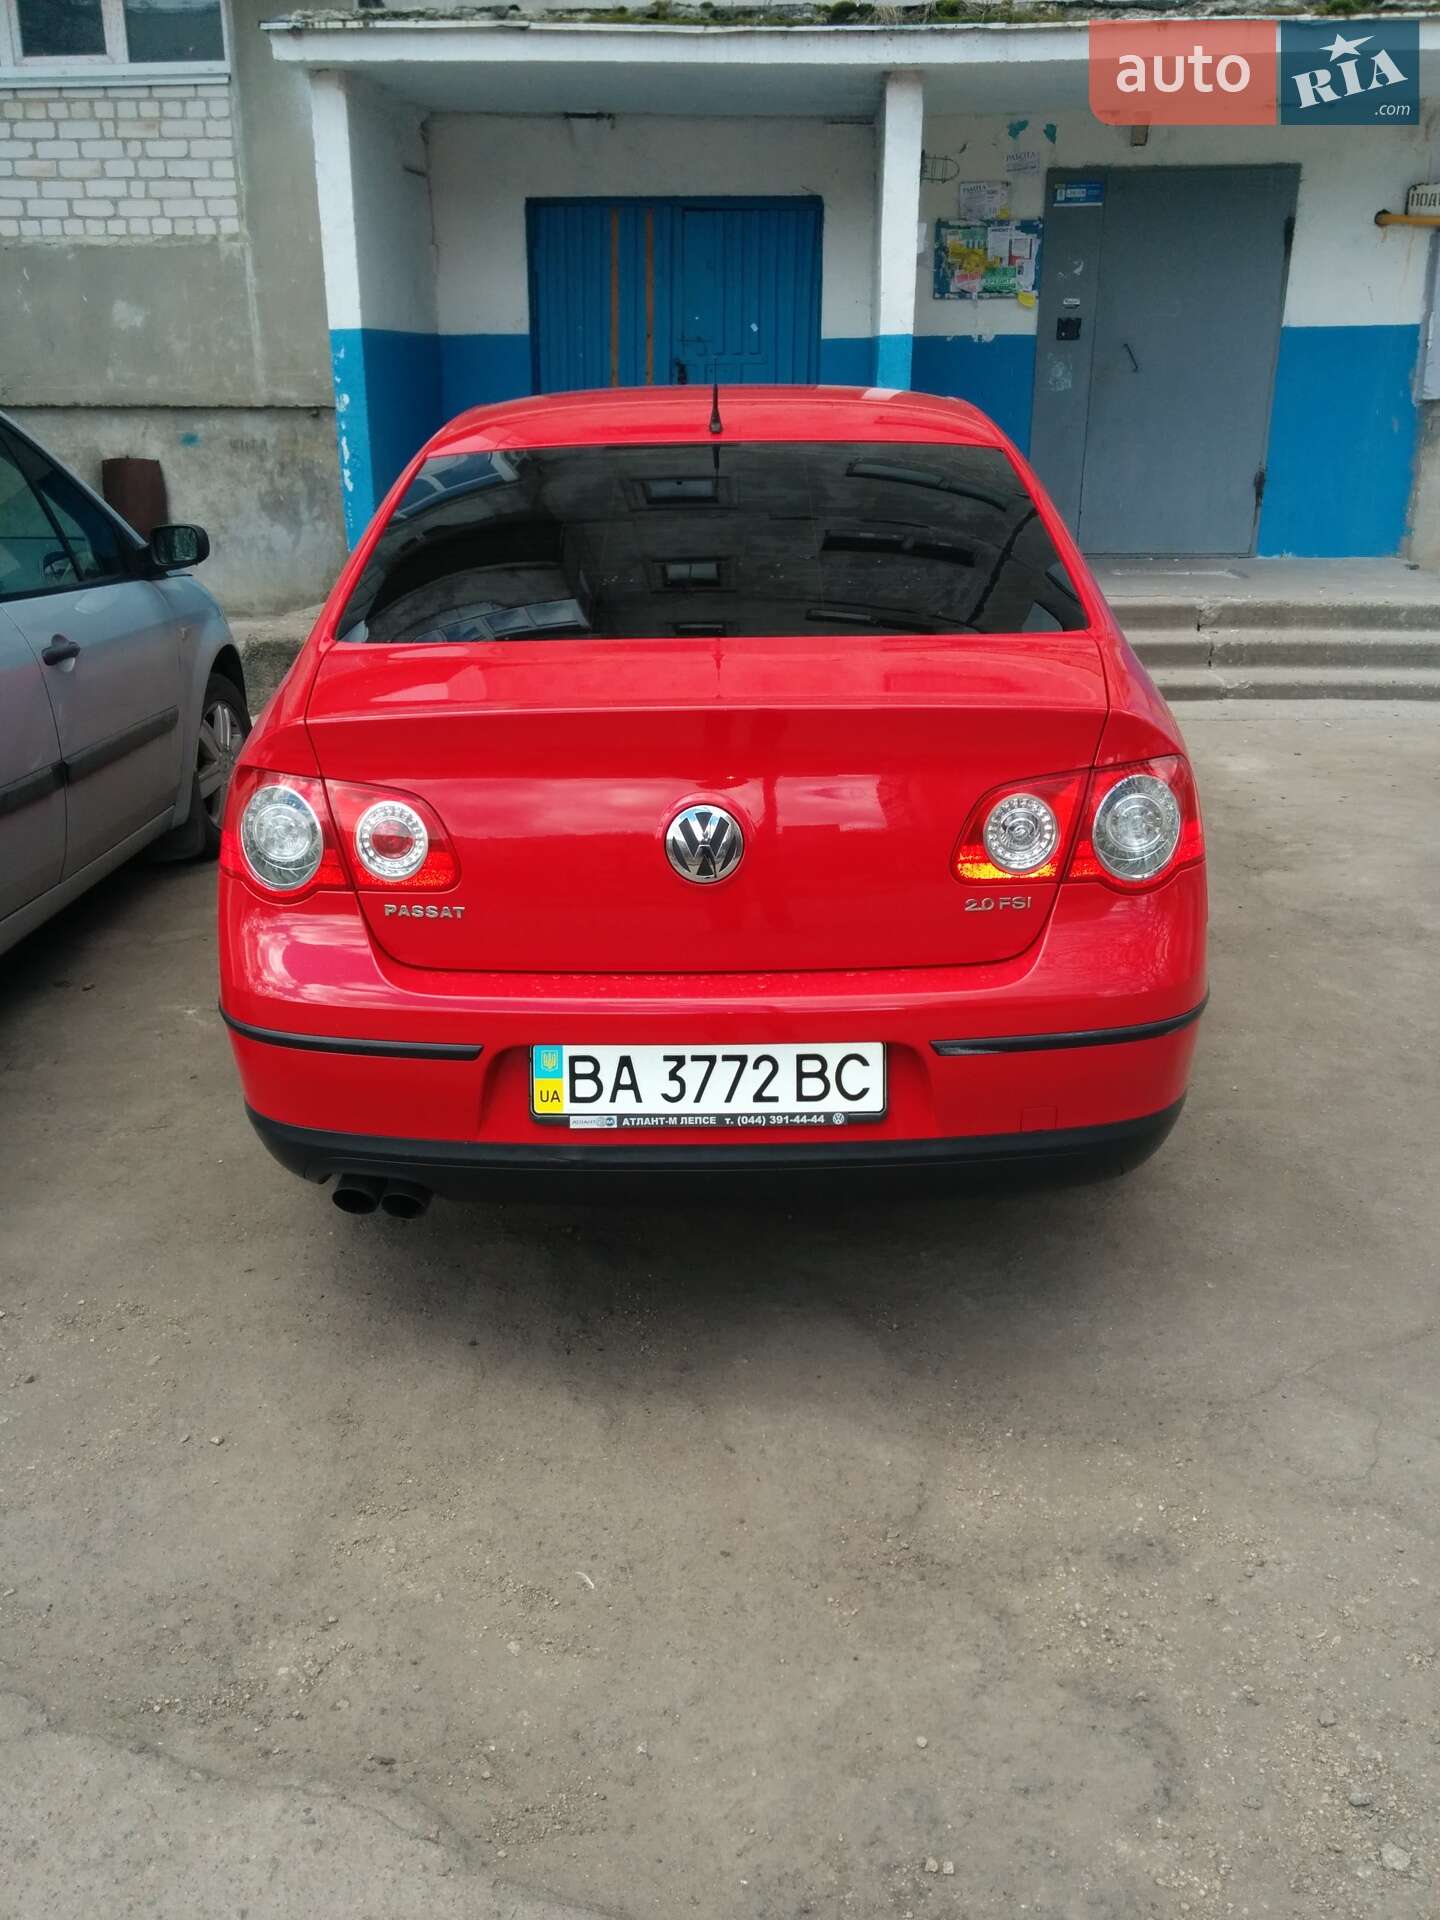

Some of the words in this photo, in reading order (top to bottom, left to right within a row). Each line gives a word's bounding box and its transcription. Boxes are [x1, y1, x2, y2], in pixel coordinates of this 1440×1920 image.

[1410, 192, 1440, 207] ПОД
[999, 896, 1032, 910] FSI
[383, 904, 465, 919] PASSAT
[568, 1055, 643, 1104] BA
[660, 1054, 780, 1104] 3772
[796, 1052, 870, 1103] BC
[540, 1090, 561, 1103] UA
[622, 1117, 677, 1126] АТЛАНТ-М
[680, 1116, 717, 1125] ЛЕПСЕ
[737, 1115, 766, 1127] (044)
[769, 1114, 825, 1125] 391-44-44
